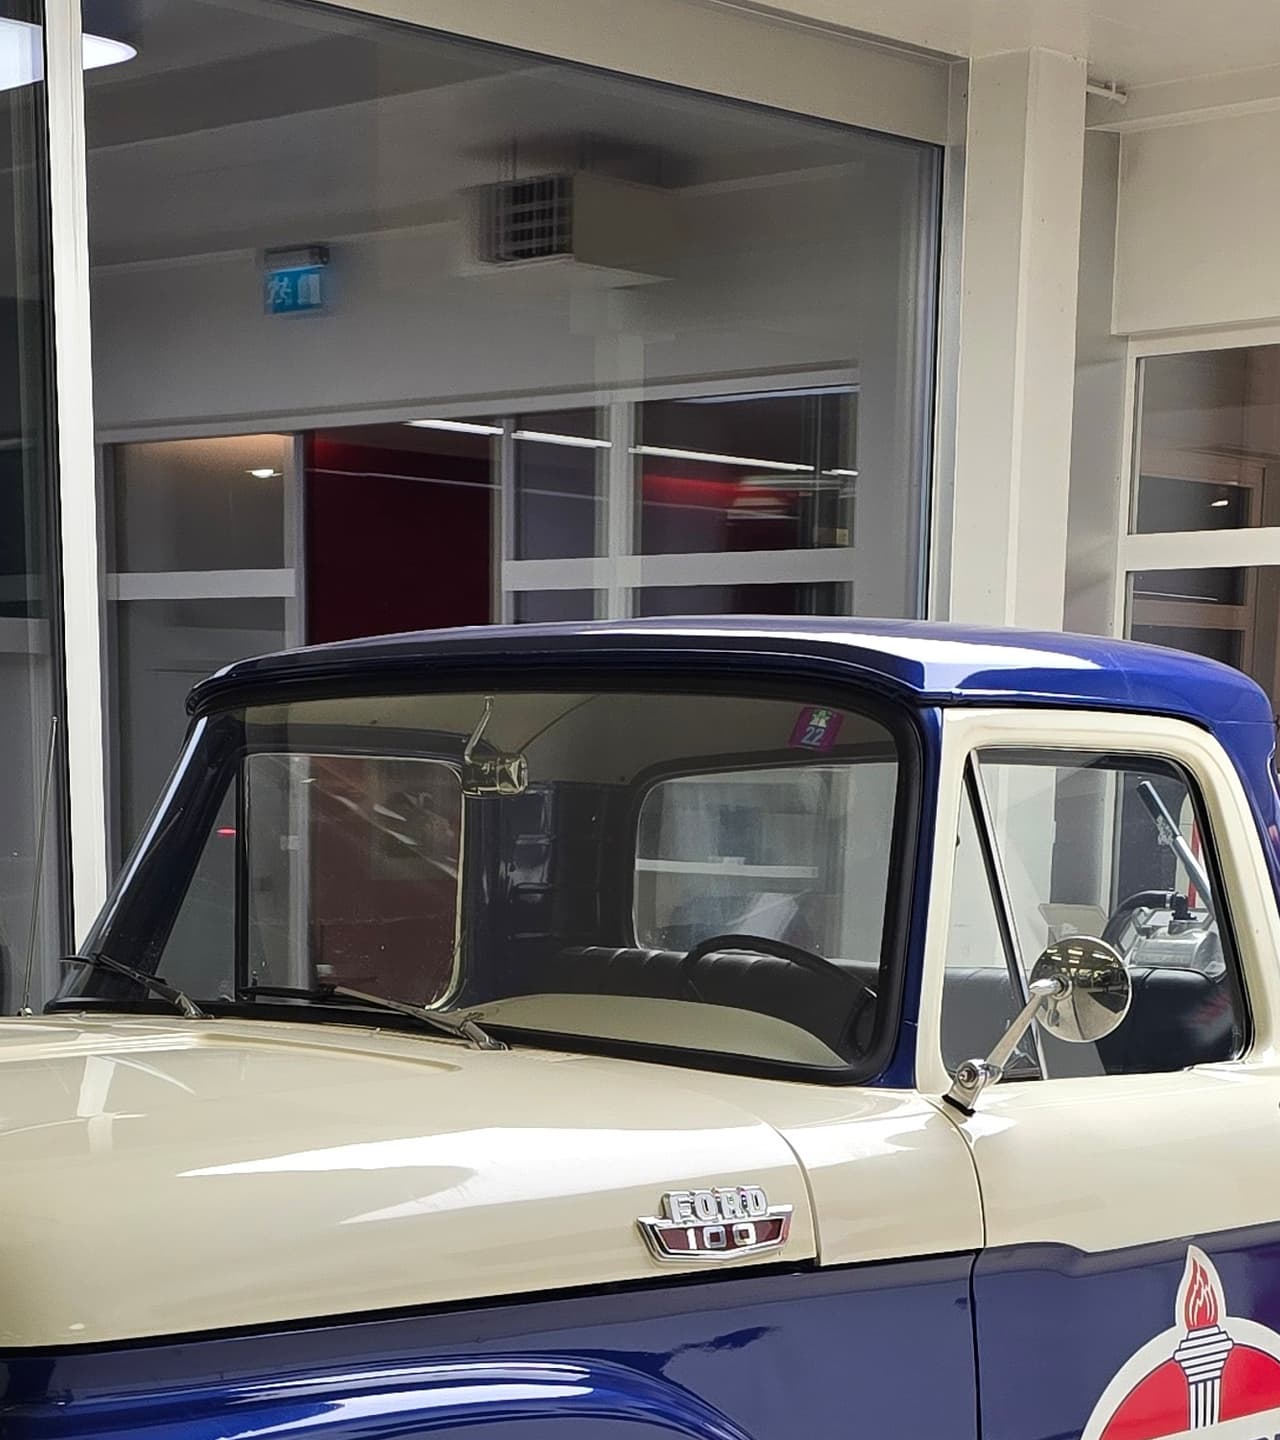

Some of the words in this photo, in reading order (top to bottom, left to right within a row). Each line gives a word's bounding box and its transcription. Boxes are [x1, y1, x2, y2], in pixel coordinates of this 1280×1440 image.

[800, 726, 825, 747] 22
[663, 1185, 768, 1224] FORD
[686, 1222, 757, 1250] 100
